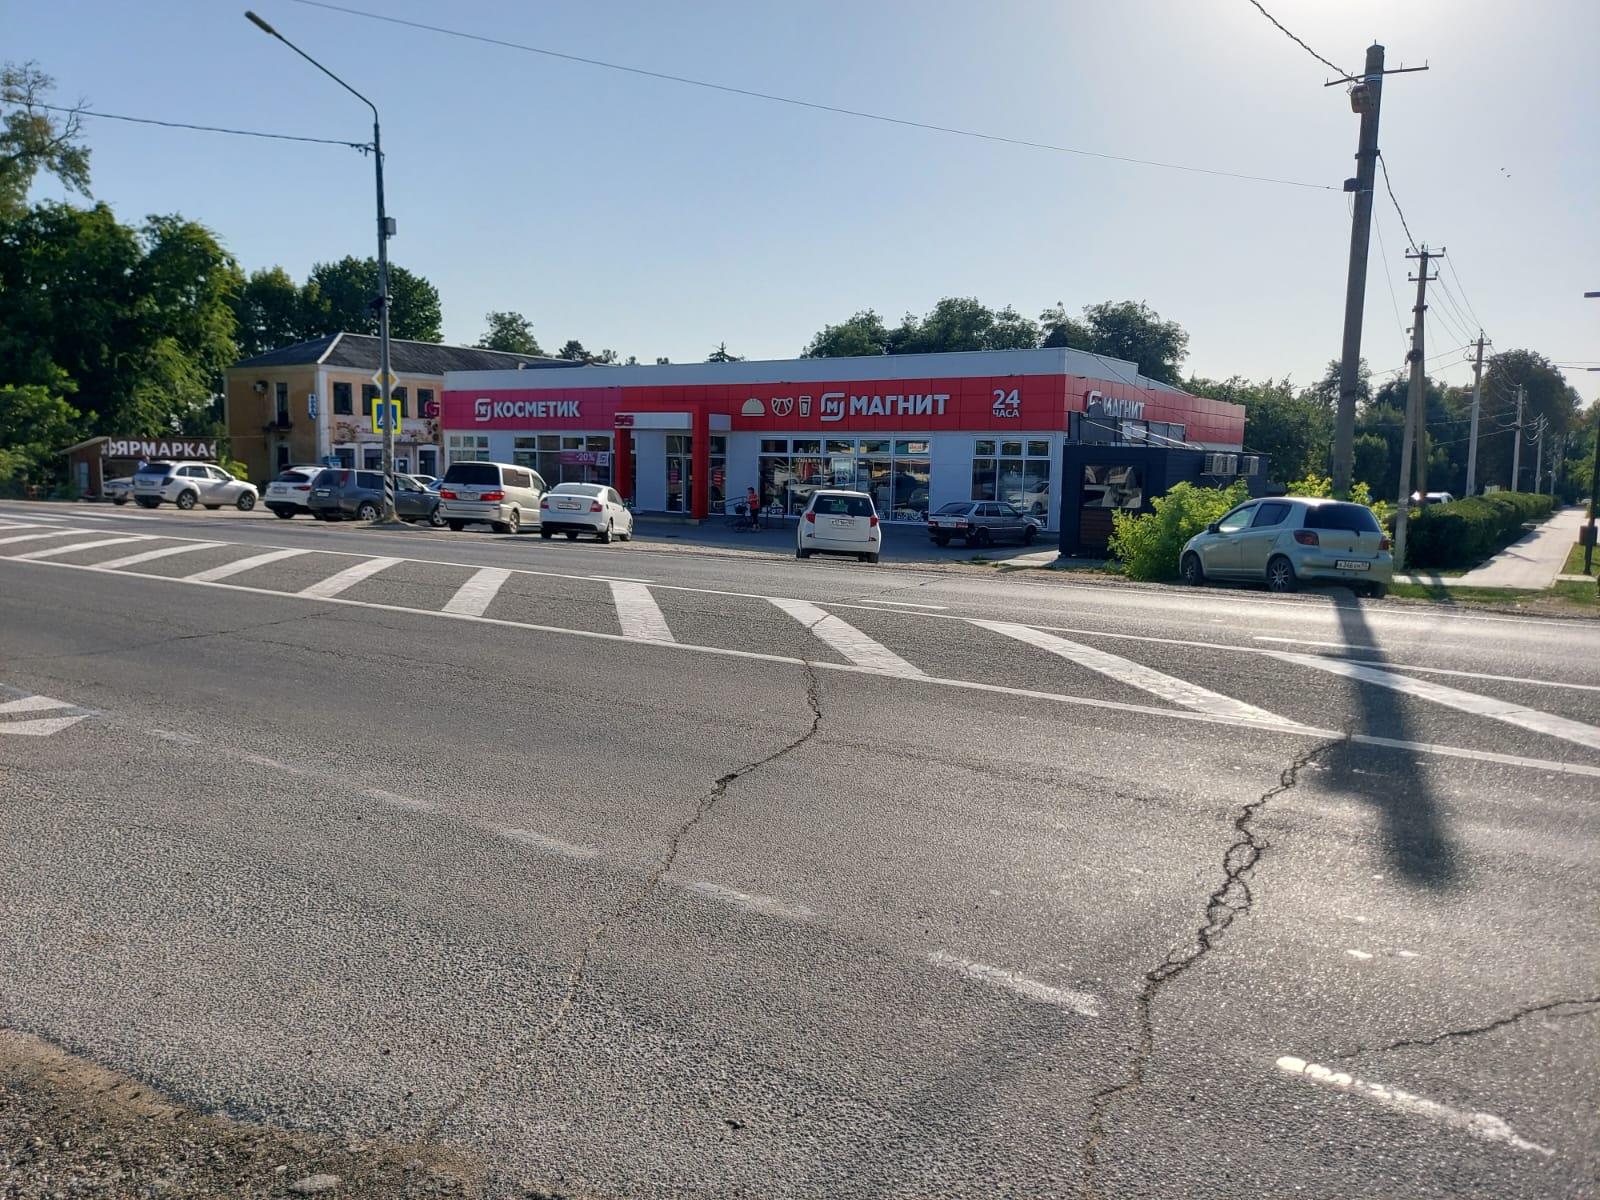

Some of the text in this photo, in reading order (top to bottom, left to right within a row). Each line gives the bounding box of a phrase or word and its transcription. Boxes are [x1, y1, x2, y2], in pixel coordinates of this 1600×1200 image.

[849, 394, 950, 416] МАГНИТ
[992, 389, 1021, 408] 24
[493, 400, 581, 418] КОСМЕТИК
[992, 409, 1020, 418] ЧАСА
[116, 440, 209, 457] ЯРМАРКА
